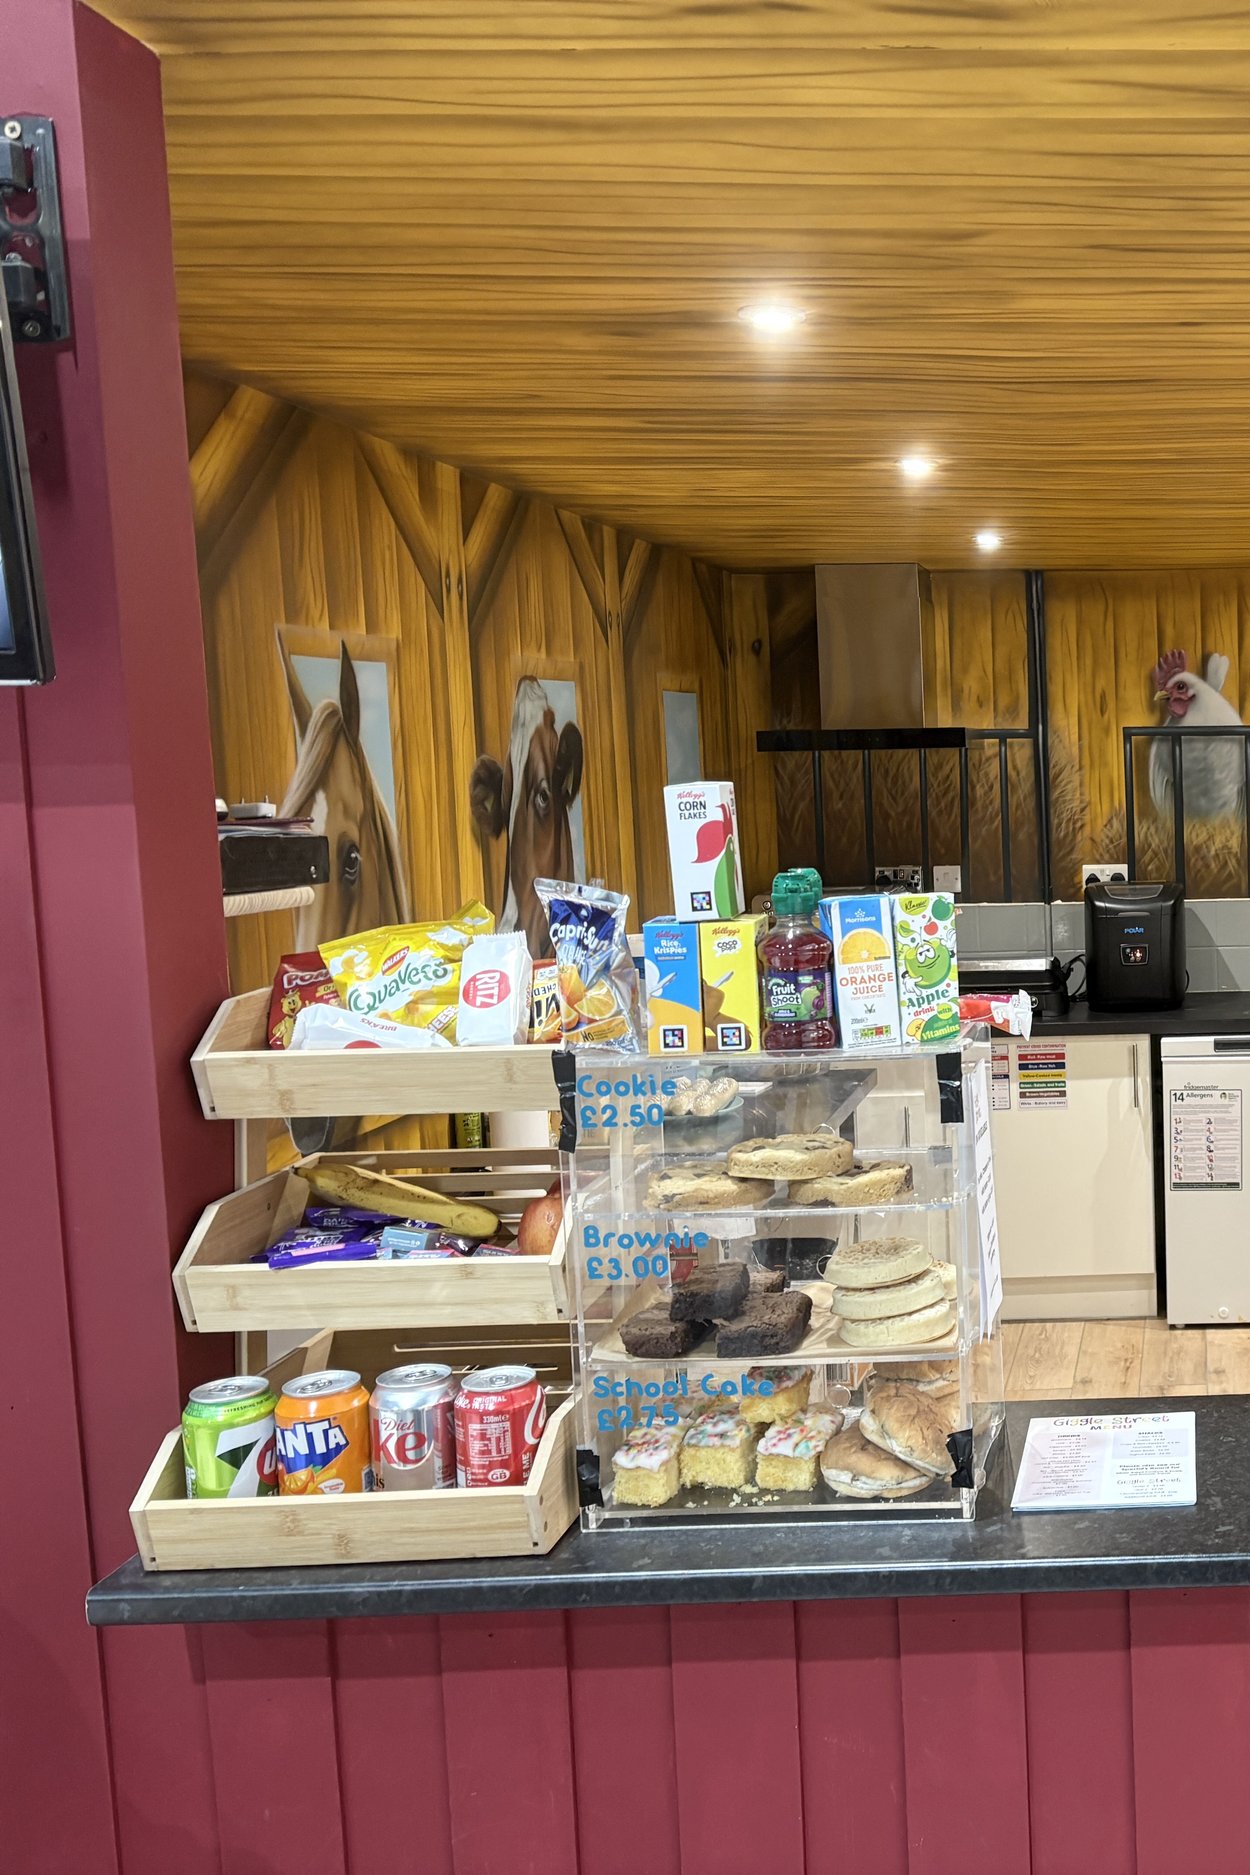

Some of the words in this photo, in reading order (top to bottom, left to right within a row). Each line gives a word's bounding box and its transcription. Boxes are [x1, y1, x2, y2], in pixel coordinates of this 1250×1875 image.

[678, 800, 706, 811] CORN
[680, 812, 707, 820] FLAKES
[845, 915, 876, 924] Morrisons
[712, 926, 740, 936] Kellogg's
[653, 946, 687, 954] Krispies
[661, 939, 679, 948] Rice
[848, 965, 864, 975] 100%
[867, 964, 884, 973] PURE
[840, 972, 894, 987] ORANGE
[475, 971, 501, 1007] RITZ
[772, 983, 796, 995] Fruit
[852, 985, 884, 995] JUICE
[772, 995, 800, 1006] Shoot
[907, 989, 950, 1008] Apple
[914, 1006, 935, 1017] drink
[937, 1007, 952, 1015] with
[360, 1017, 399, 1032] BREAKS
[428, 1006, 458, 1033] HEESE
[922, 1024, 960, 1040] Vitamins
[576, 1074, 678, 1098] Cookie
[1173, 1092, 1184, 1103] 14
[580, 1103, 665, 1129] £2.50
[583, 1225, 710, 1249] Brownie
[586, 1254, 669, 1280] £3.00
[593, 1374, 688, 1399] School
[700, 1373, 774, 1398] Cake
[473, 1395, 507, 1404] ORIGINAL
[597, 1403, 680, 1432] £2.75
[1054, 1417, 1104, 1427] Giggle
[1112, 1415, 1170, 1425] Street
[381, 1417, 416, 1432] Diet
[276, 1420, 346, 1459] ANTA
[373, 1418, 427, 1465] ke
[215, 1414, 278, 1498] 7
[263, 1450, 278, 1475] U
[491, 1472, 507, 1481] GB
